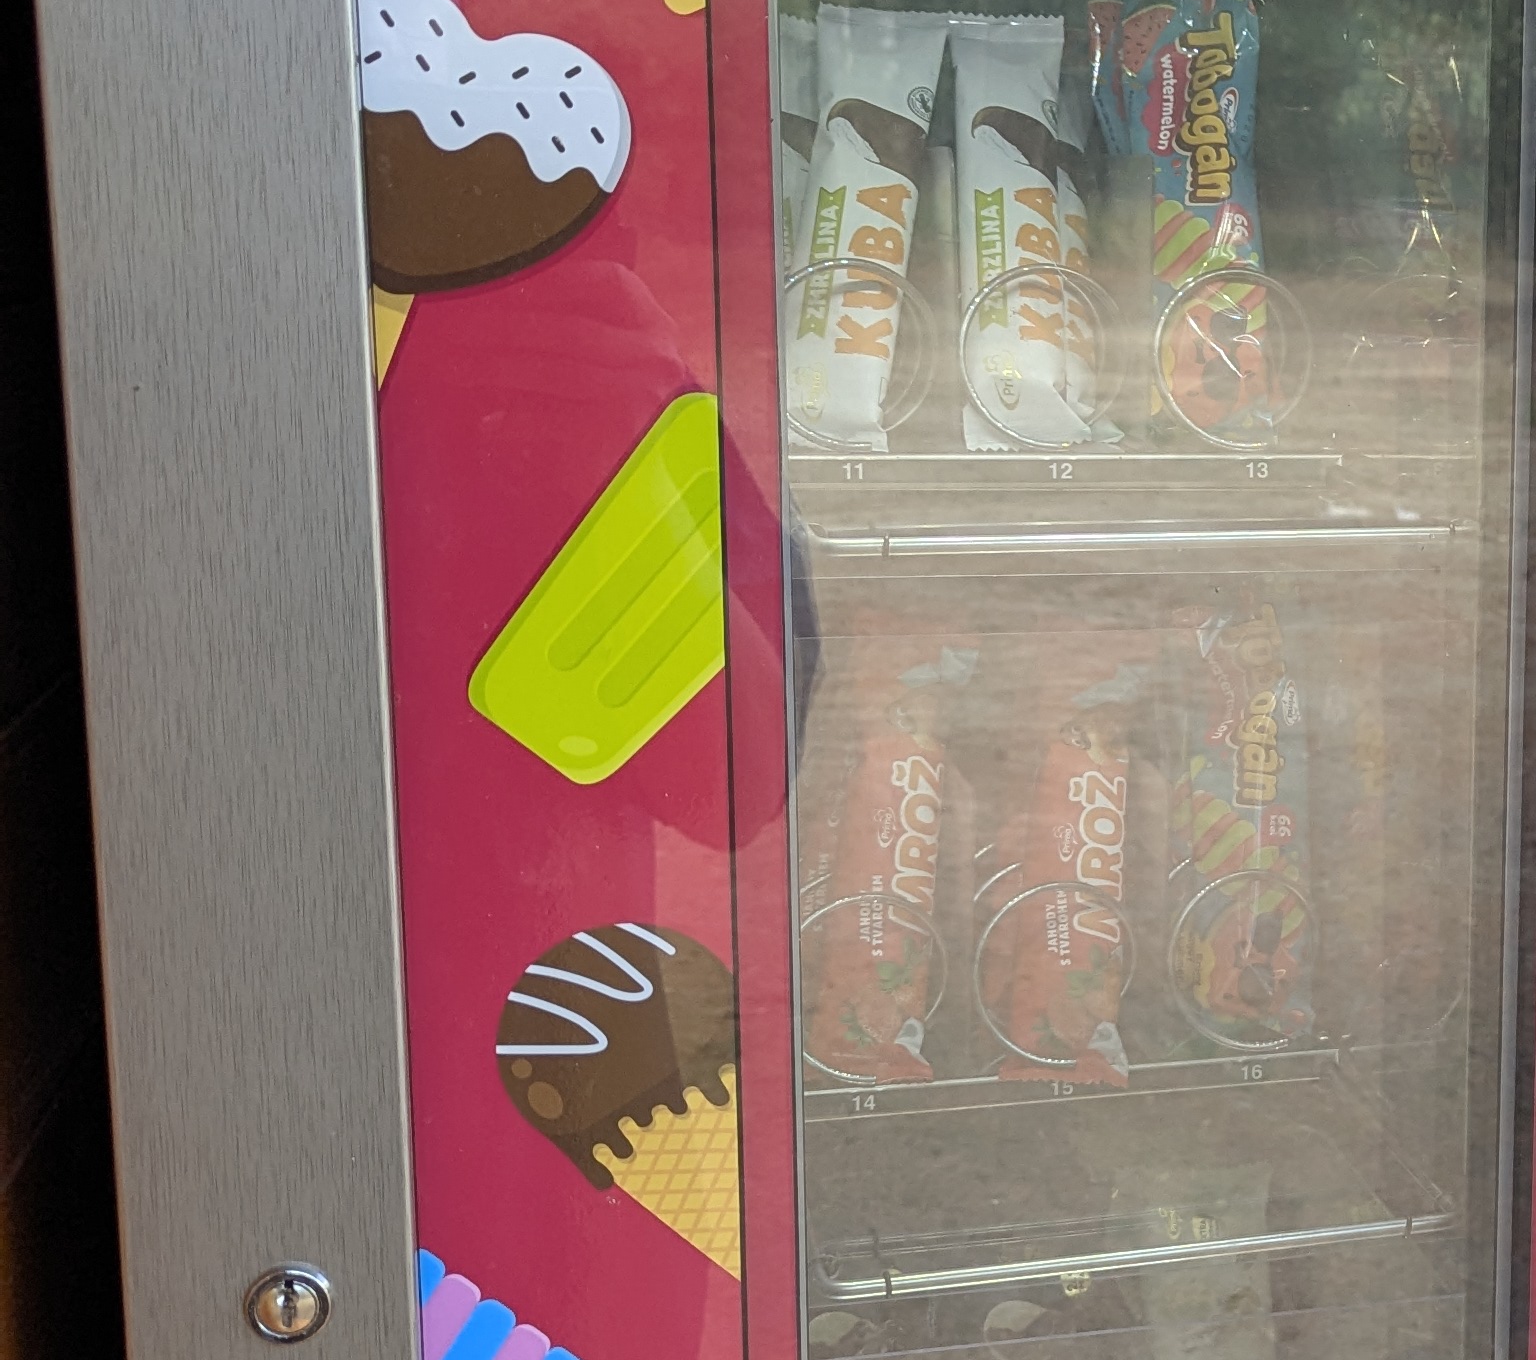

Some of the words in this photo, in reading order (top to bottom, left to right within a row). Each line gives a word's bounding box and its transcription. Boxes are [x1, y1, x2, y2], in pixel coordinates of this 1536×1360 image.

[1156, 53, 1176, 152] watermelon
[806, 204, 840, 321] ZMRLINA
[834, 183, 912, 361] KUBA
[843, 464, 865, 480] 11
[1049, 463, 1073, 480] 12
[1245, 462, 1269, 480] 13
[1073, 771, 1127, 943] MROŽ
[871, 875, 883, 946] TVAROEM
[1241, 1064, 1263, 1081] 16
[1050, 1080, 1074, 1096] 15
[852, 1094, 877, 1112] 14
